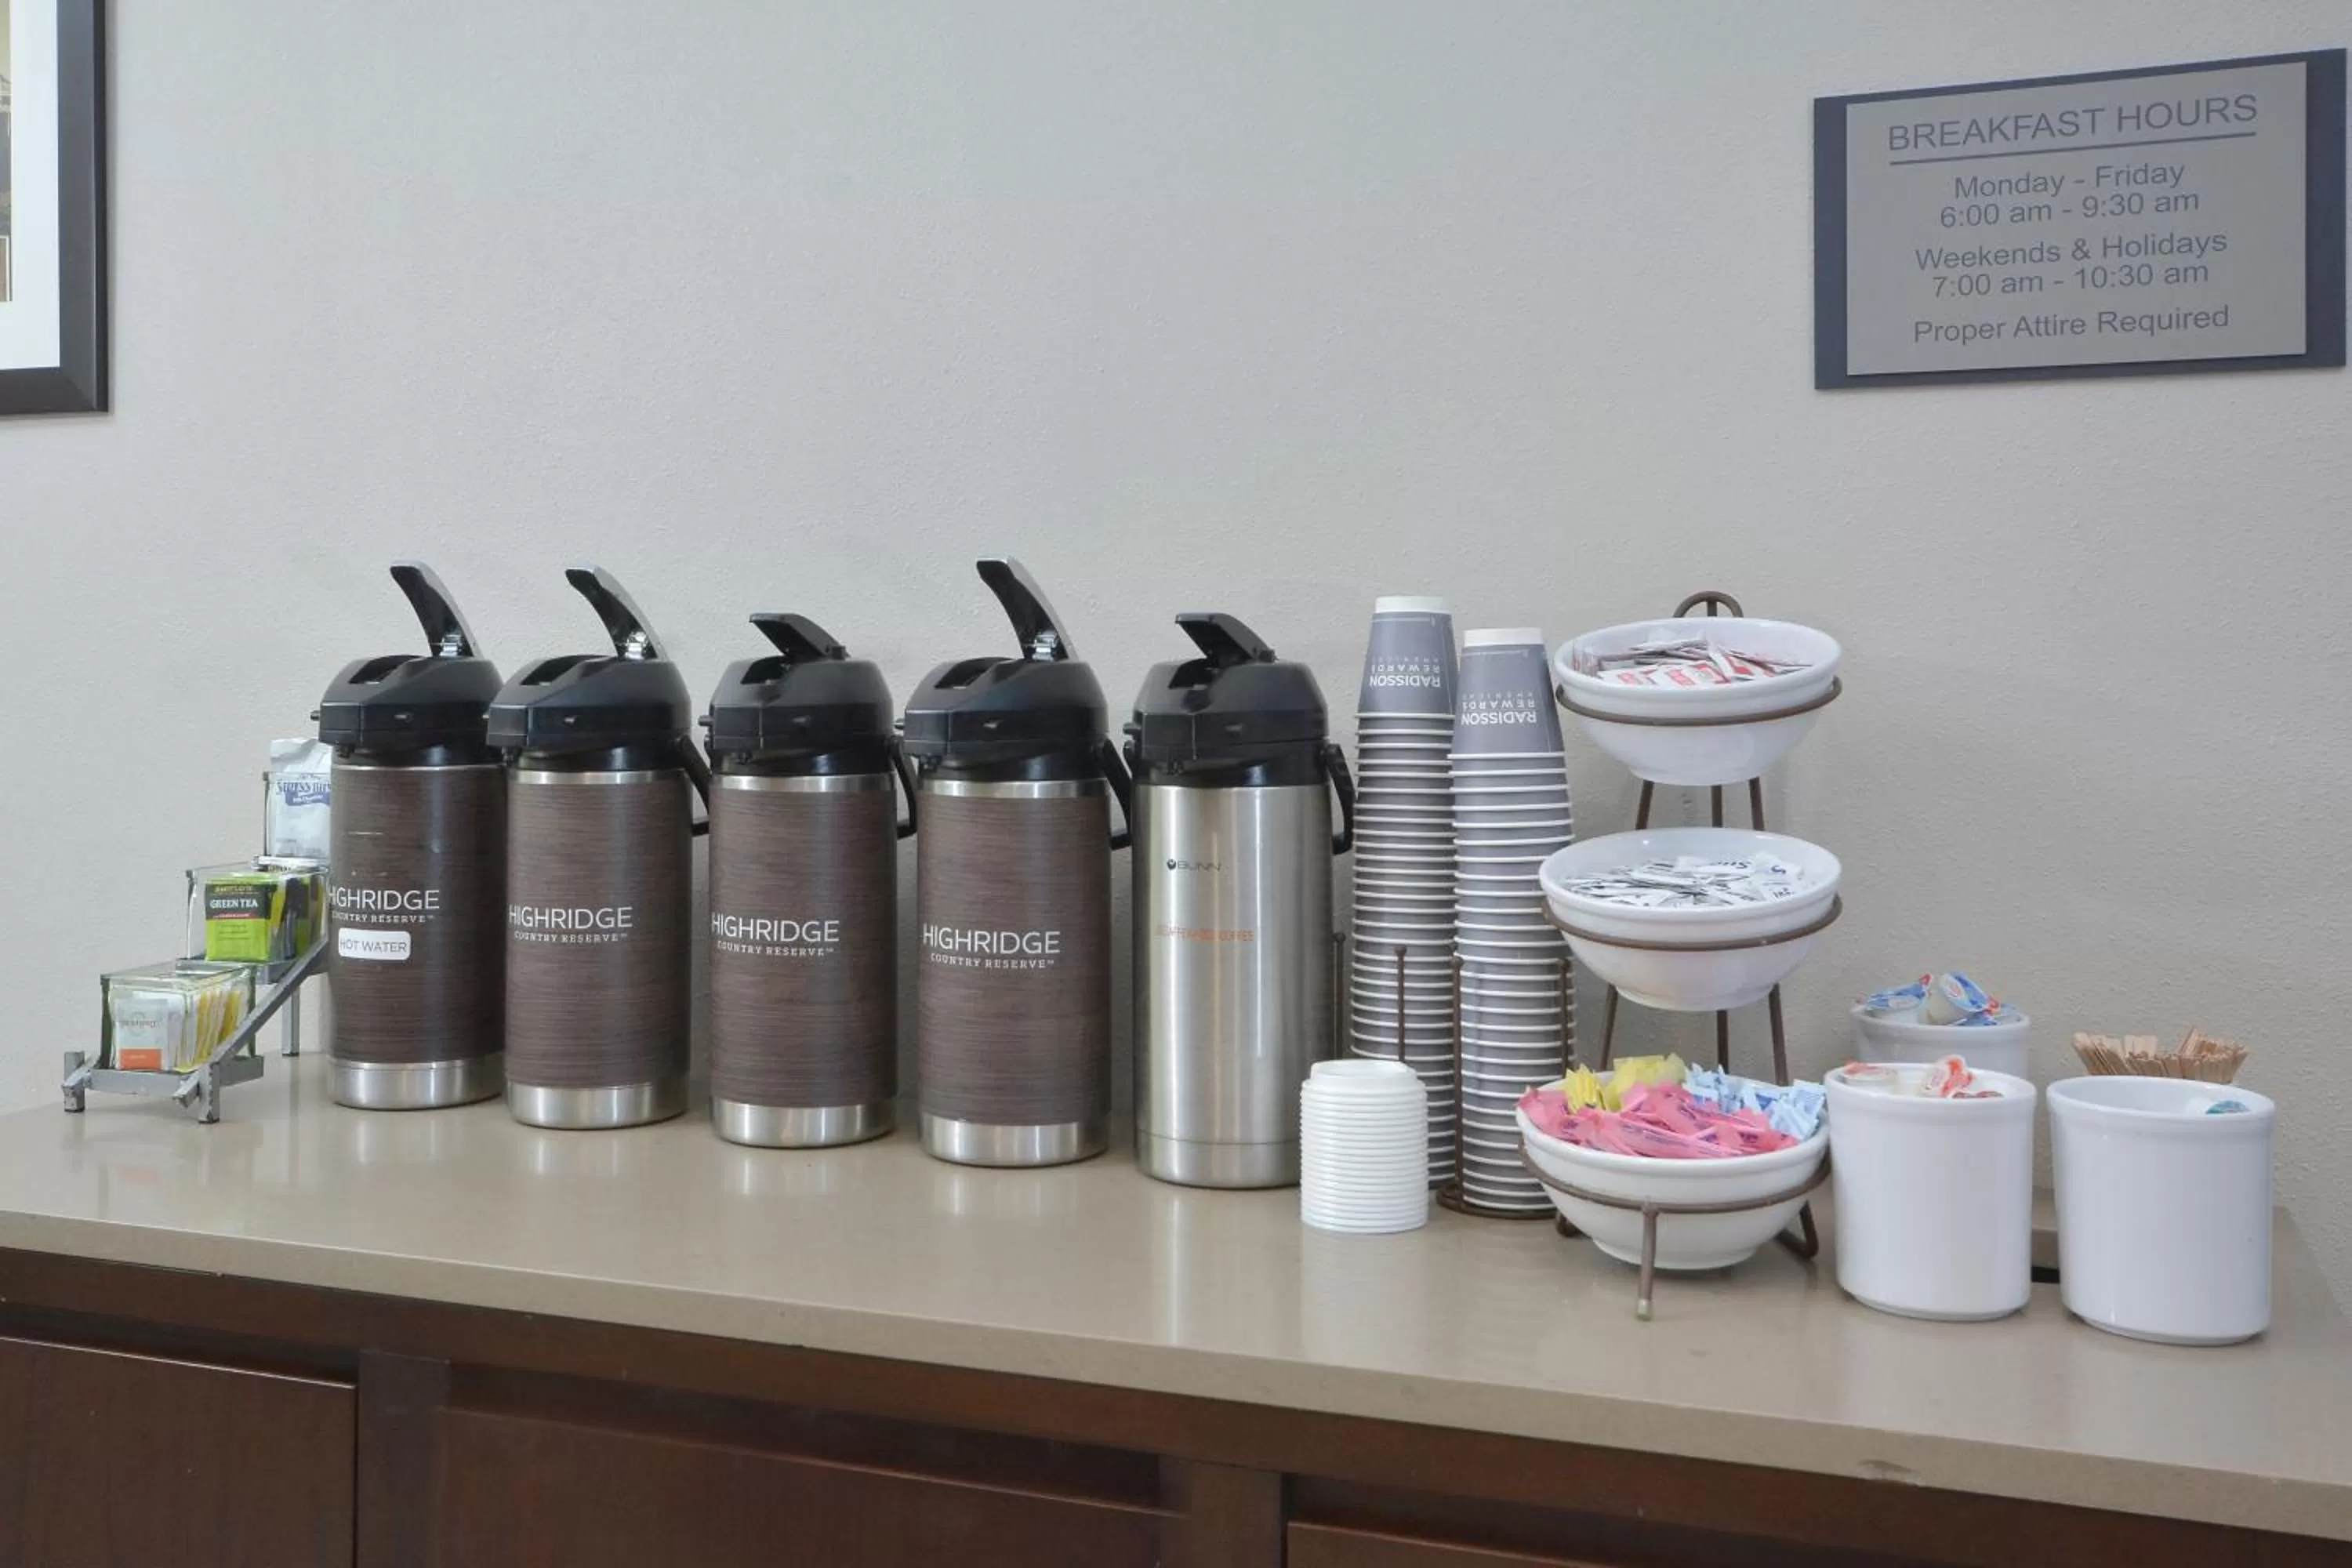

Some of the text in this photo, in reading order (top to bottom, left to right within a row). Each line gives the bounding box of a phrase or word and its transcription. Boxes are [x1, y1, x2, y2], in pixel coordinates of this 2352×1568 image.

[1889, 93, 2259, 151] BREAKFAST HOURS
[1955, 171, 2066, 199] Monday
[2096, 162, 2186, 189] Friday
[1940, 202, 2000, 228] 6:00
[2009, 202, 2053, 223] am
[2082, 192, 2145, 219] 9:30
[2154, 193, 2200, 212] am
[1915, 231, 2228, 270] Weekends & Holidays
[1933, 273, 1991, 299] 7:00
[2000, 274, 2044, 294] am
[2074, 263, 2154, 290] 10:30
[2164, 263, 2209, 285] am
[1914, 303, 2230, 347] Proper Attire Required
[1370, 674, 1441, 688] RADISSON
[1461, 710, 1537, 726] RADISSON
[209, 898, 259, 909] GREEN TEA
[509, 904, 633, 929] HIGHRIDGE
[711, 911, 840, 942] HIGHRIDGE
[923, 921, 1061, 954] HIGHRIDGE
[339, 938, 408, 953] HOT WATER
[931, 952, 982, 967] COUNTRY
